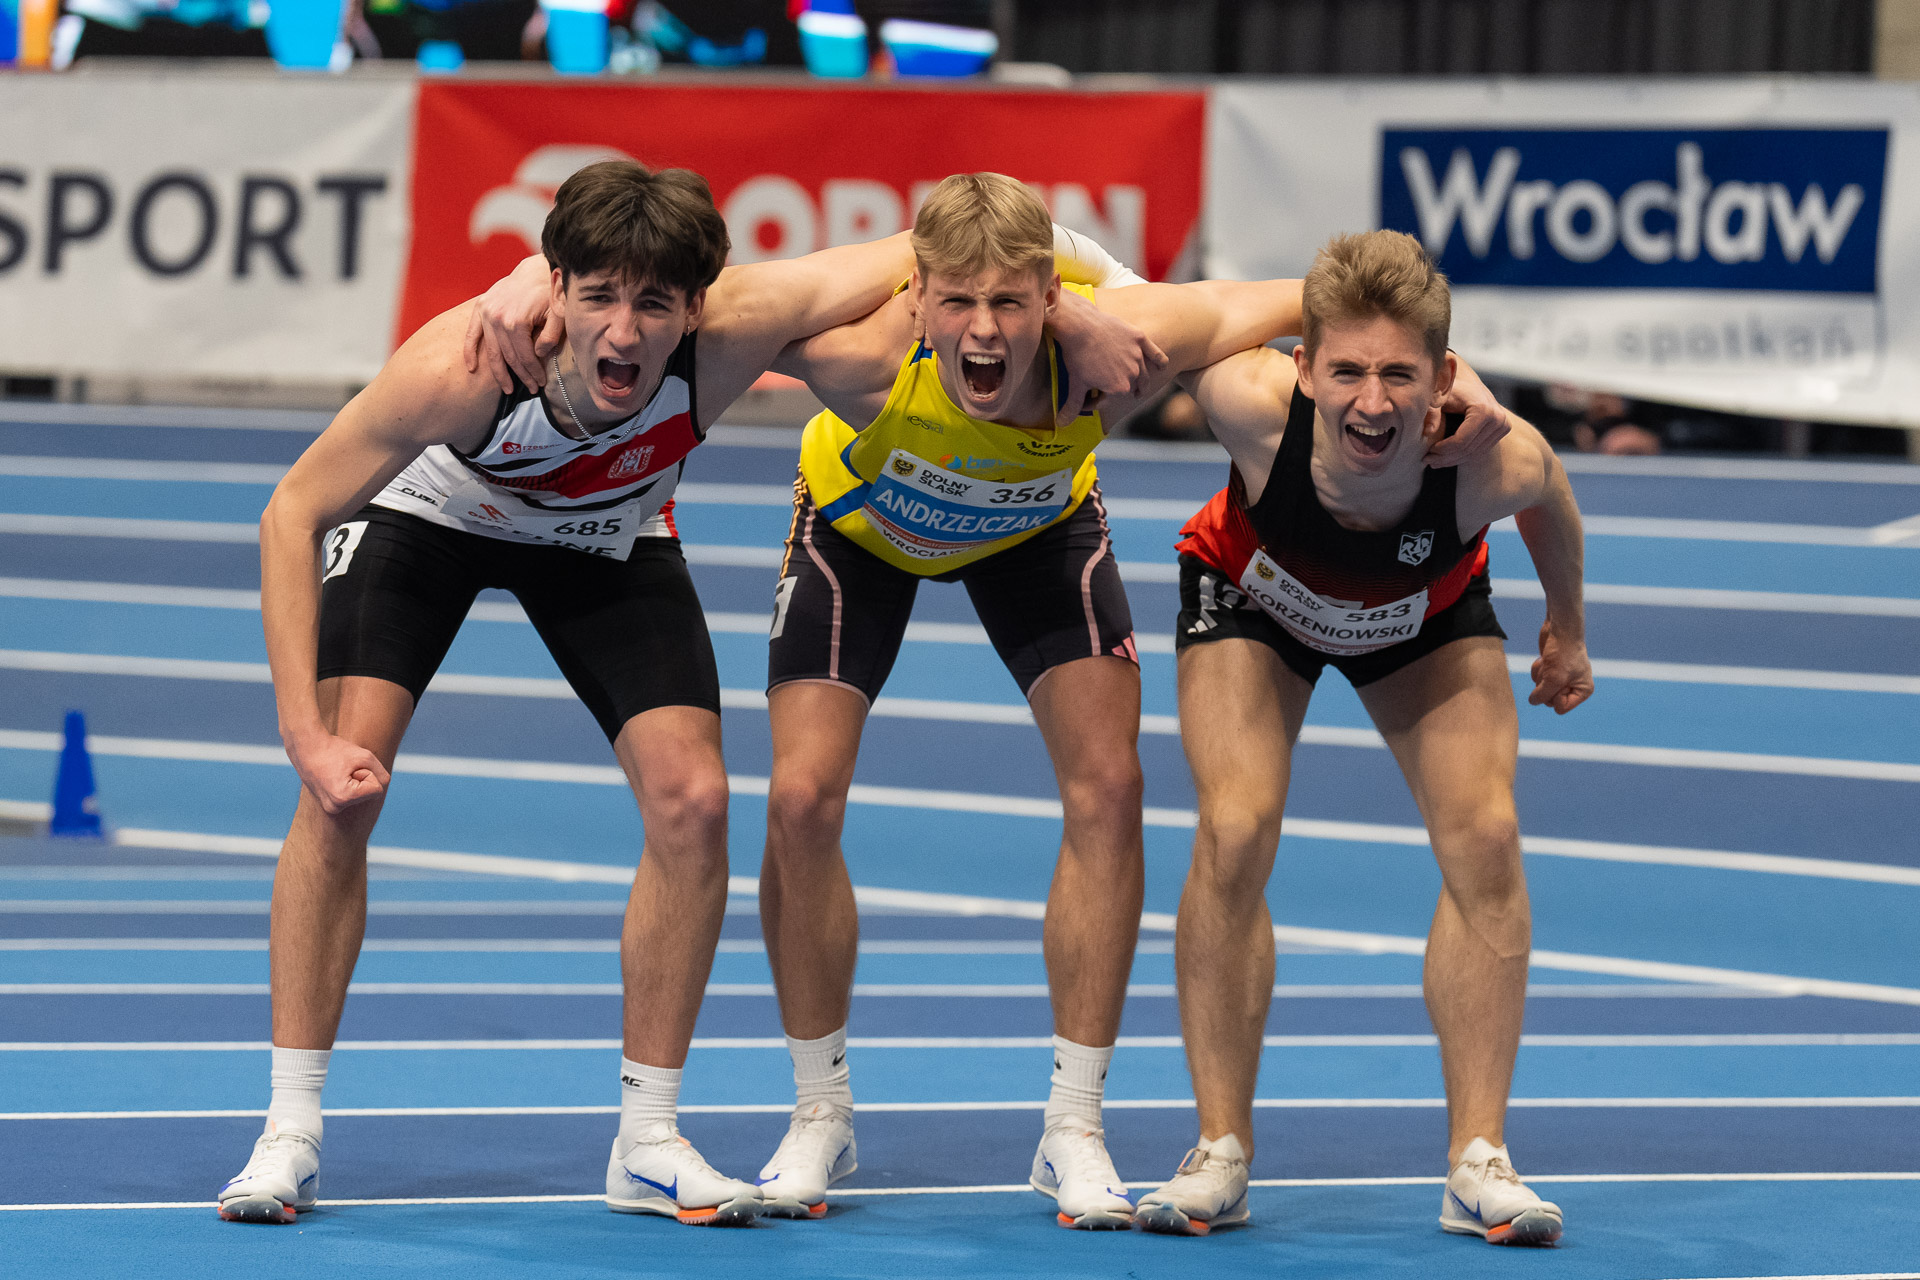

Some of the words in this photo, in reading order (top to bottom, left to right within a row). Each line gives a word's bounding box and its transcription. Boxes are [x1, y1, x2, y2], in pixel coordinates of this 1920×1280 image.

[1398, 141, 1866, 265] Wrocław
[921, 469, 973, 492] DOLNY
[988, 483, 1056, 505] 356
[875, 488, 1048, 534] ANDRZEJCZAK
[553, 518, 622, 536] 685
[1281, 579, 1325, 610] DOLNY
[1247, 584, 1415, 640] KORZENIOWSKI
[1344, 603, 1412, 623] 583
